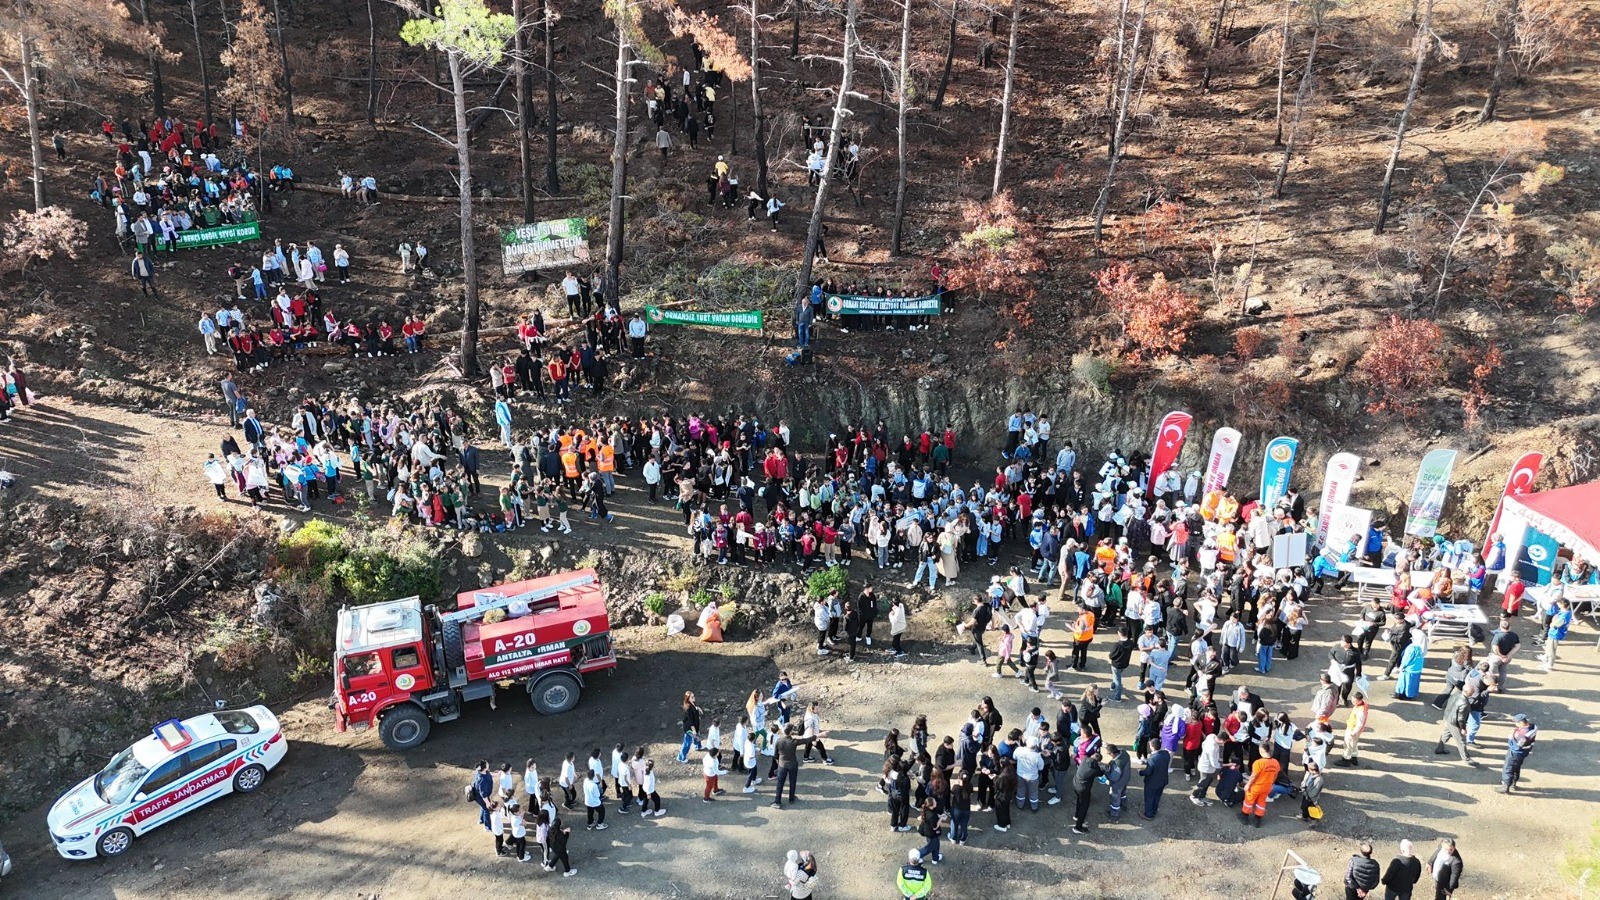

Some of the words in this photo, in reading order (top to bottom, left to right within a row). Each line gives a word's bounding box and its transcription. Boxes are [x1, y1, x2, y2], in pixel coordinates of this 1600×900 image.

[494, 632, 536, 653] A-20
[496, 649, 533, 663] ANTALYA
[488, 671, 500, 679] ALO
[173, 768, 228, 801] JANDARMASI
